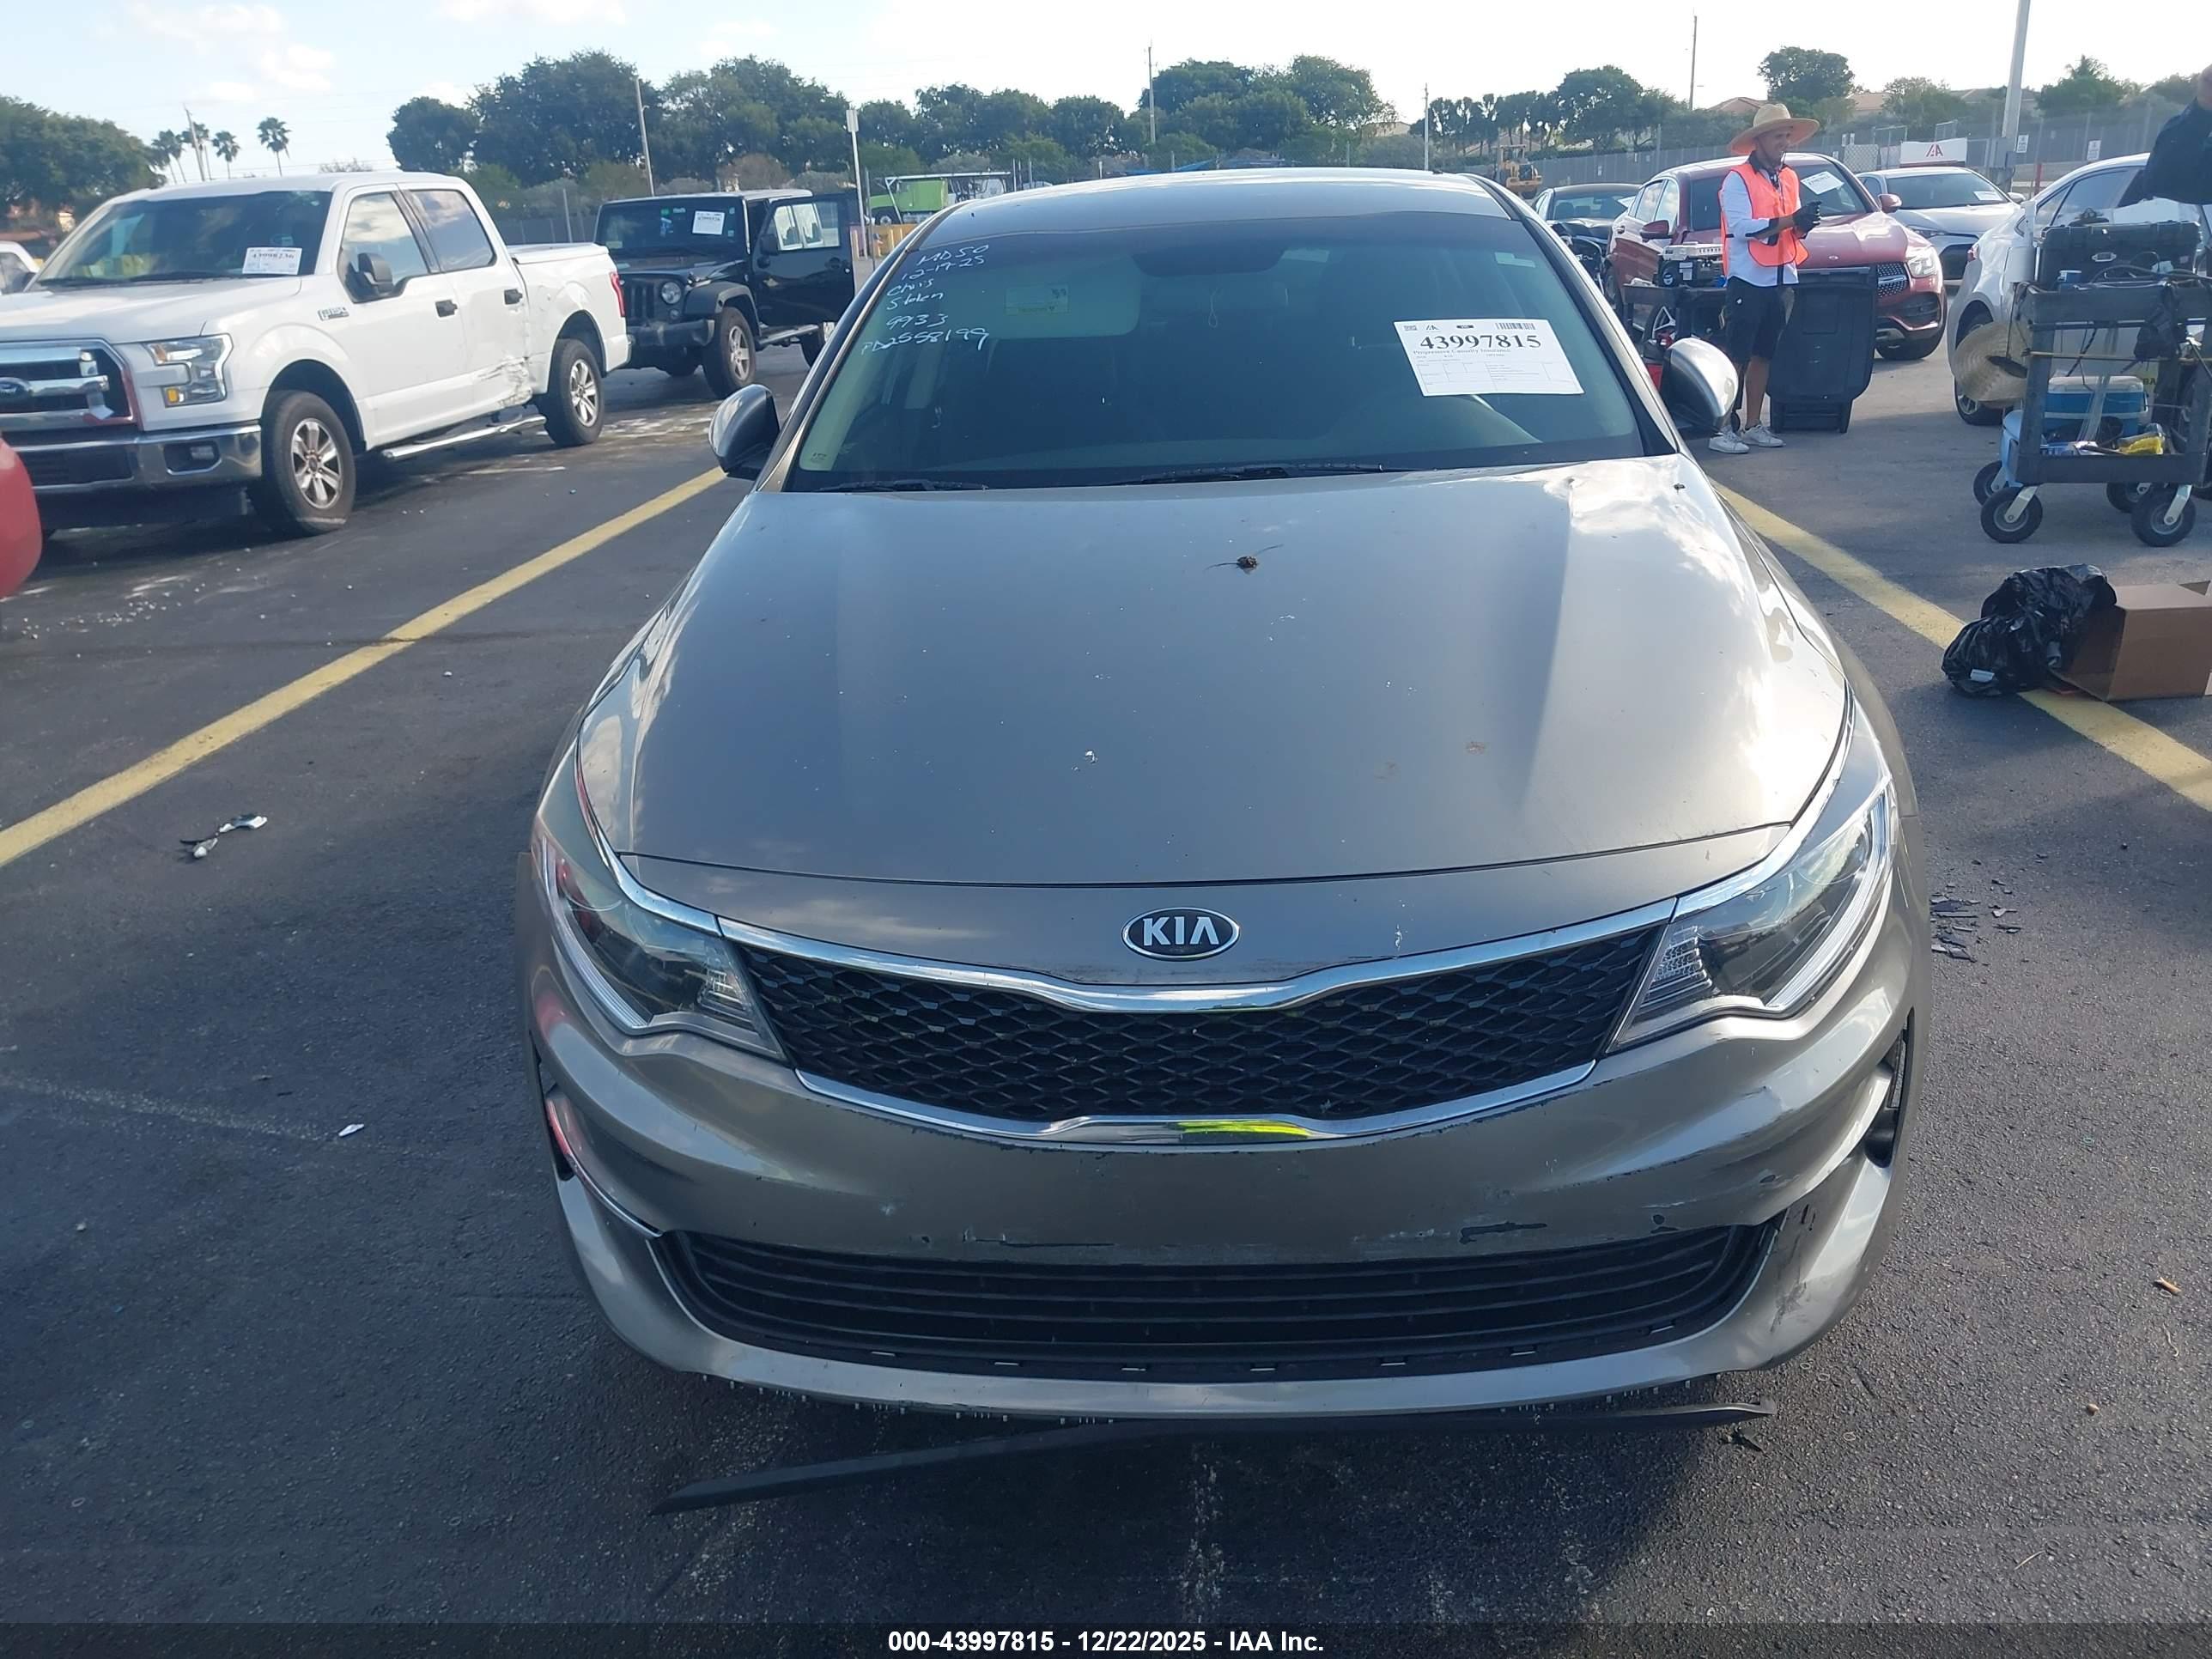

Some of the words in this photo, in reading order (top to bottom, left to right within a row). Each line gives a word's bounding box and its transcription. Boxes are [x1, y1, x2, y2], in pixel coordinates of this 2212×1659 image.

[886, 313, 949, 331] 9933
[1420, 334, 1541, 349] 43997815
[1142, 915, 1220, 946] KIA
